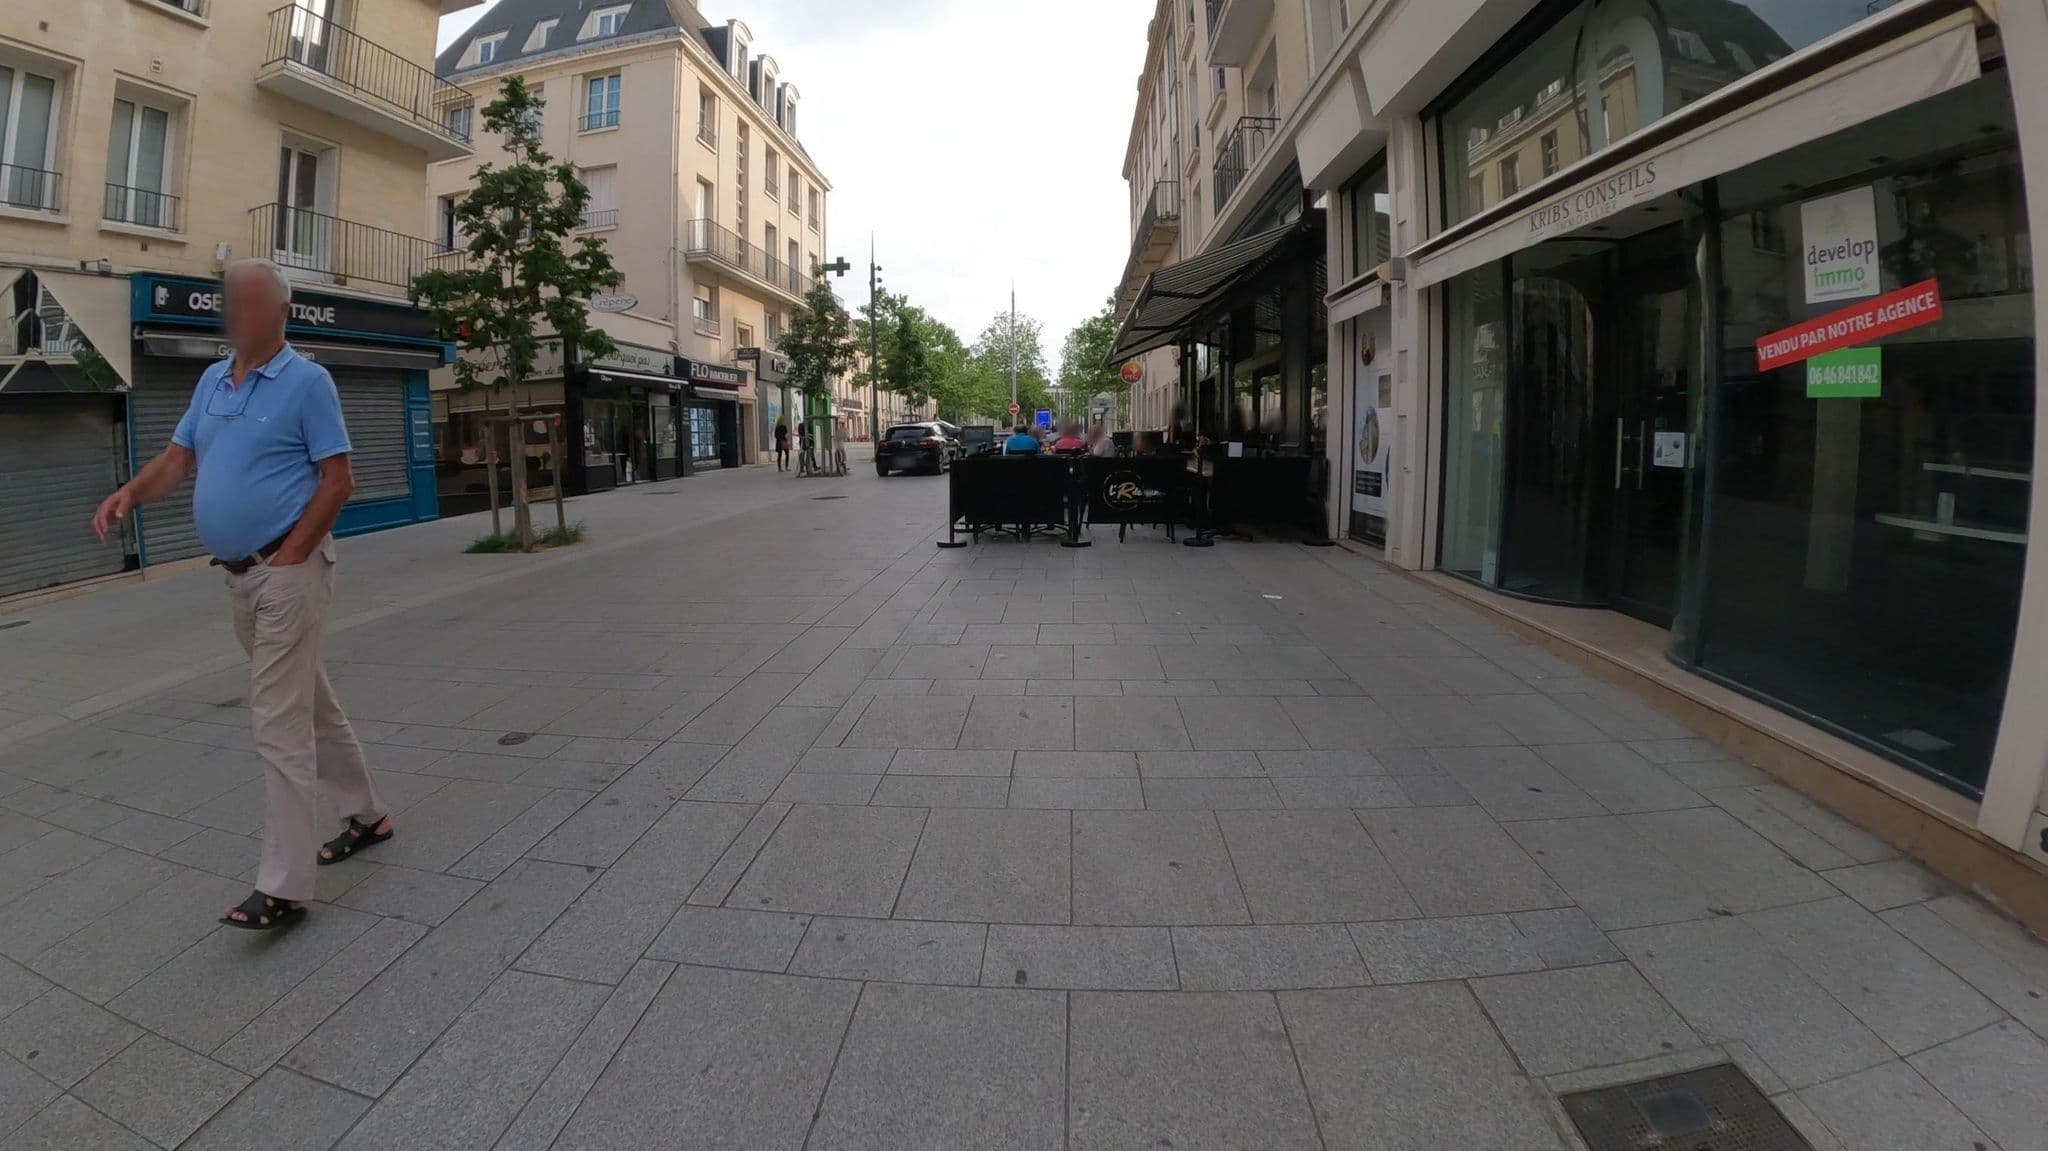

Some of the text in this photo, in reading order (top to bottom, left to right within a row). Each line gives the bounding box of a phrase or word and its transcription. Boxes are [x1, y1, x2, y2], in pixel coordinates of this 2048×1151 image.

[1529, 161, 1657, 232] KRIBS CONSEILS
[1807, 238, 1875, 265] develop
[1814, 266, 1866, 289] immo
[290, 302, 336, 325] TIQUE
[1758, 291, 1937, 361] VENDU PAR NOTRE AGENCE
[690, 362, 709, 378] FLO
